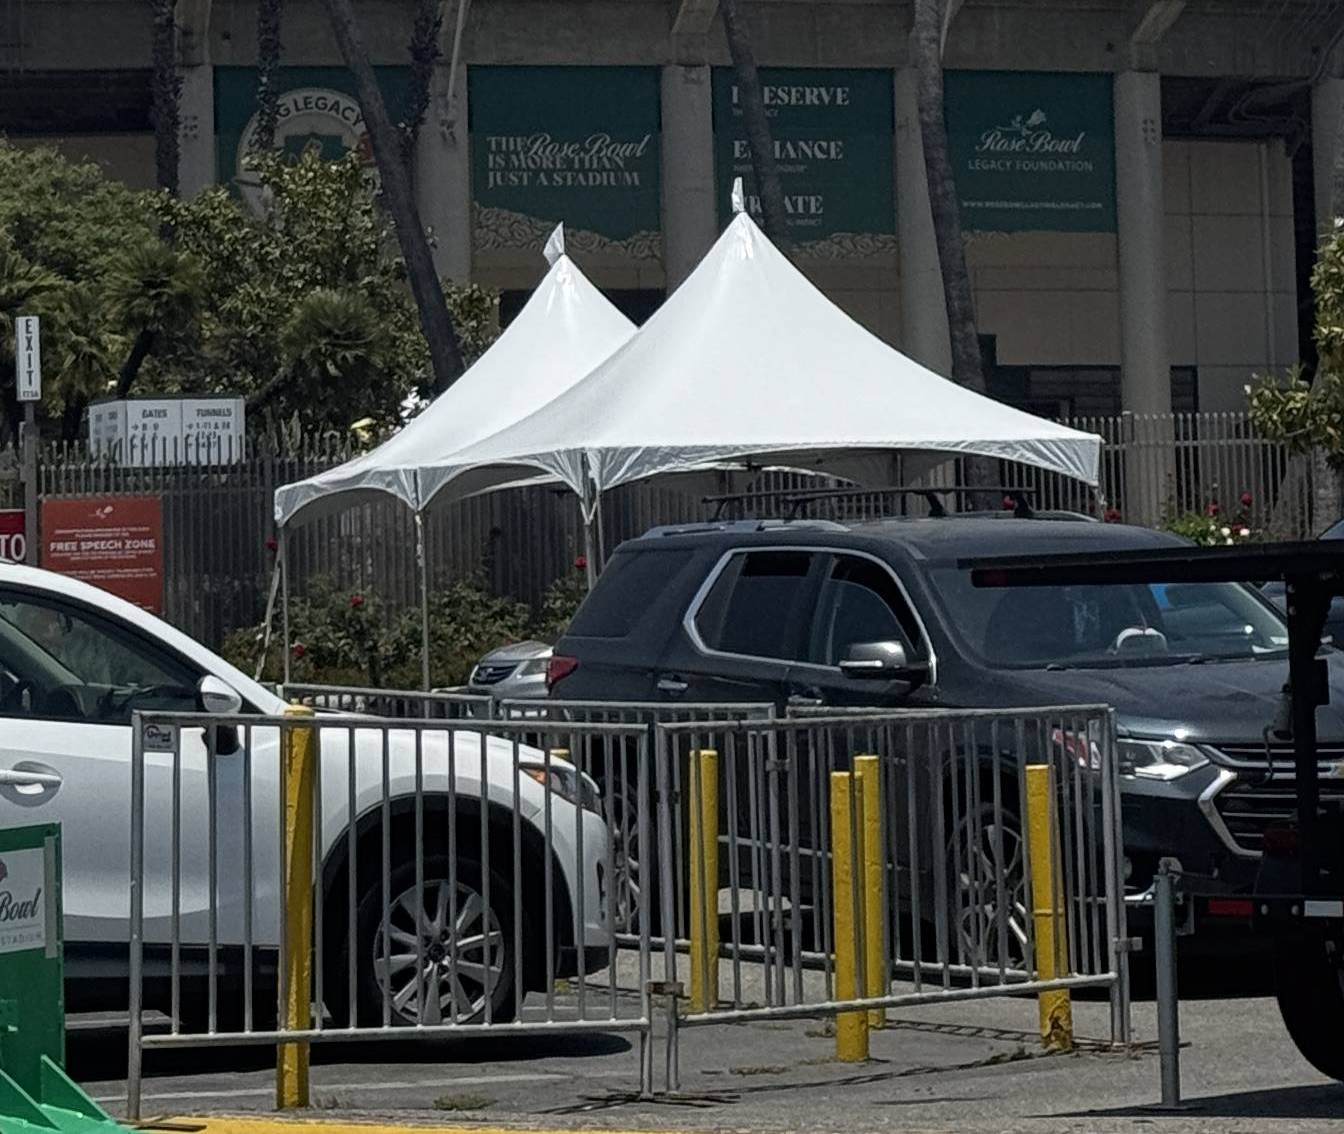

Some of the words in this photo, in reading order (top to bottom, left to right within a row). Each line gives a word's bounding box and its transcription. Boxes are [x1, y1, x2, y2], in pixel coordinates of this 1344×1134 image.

[732, 85, 850, 106] ESERVE
[292, 95, 365, 127] LEGACY
[486, 136, 528, 152] THE
[526, 133, 581, 158] Rose
[581, 132, 652, 158] Bowl
[733, 140, 844, 160] EANCE
[974, 130, 1026, 152] Rose
[1025, 130, 1086, 153] Bowl
[488, 154, 506, 170] IS
[509, 152, 567, 170] MORE
[967, 159, 1013, 171] LEGACY
[1016, 159, 1093, 172] FOUNDATION
[488, 171, 533, 190] JUST
[537, 171, 549, 187] A
[552, 171, 641, 187] STADIUM
[24, 318, 34, 387] EXIT
[49, 541, 79, 552] FREE
[80, 539, 123, 551] SPEECH
[124, 538, 156, 550] ZONE
